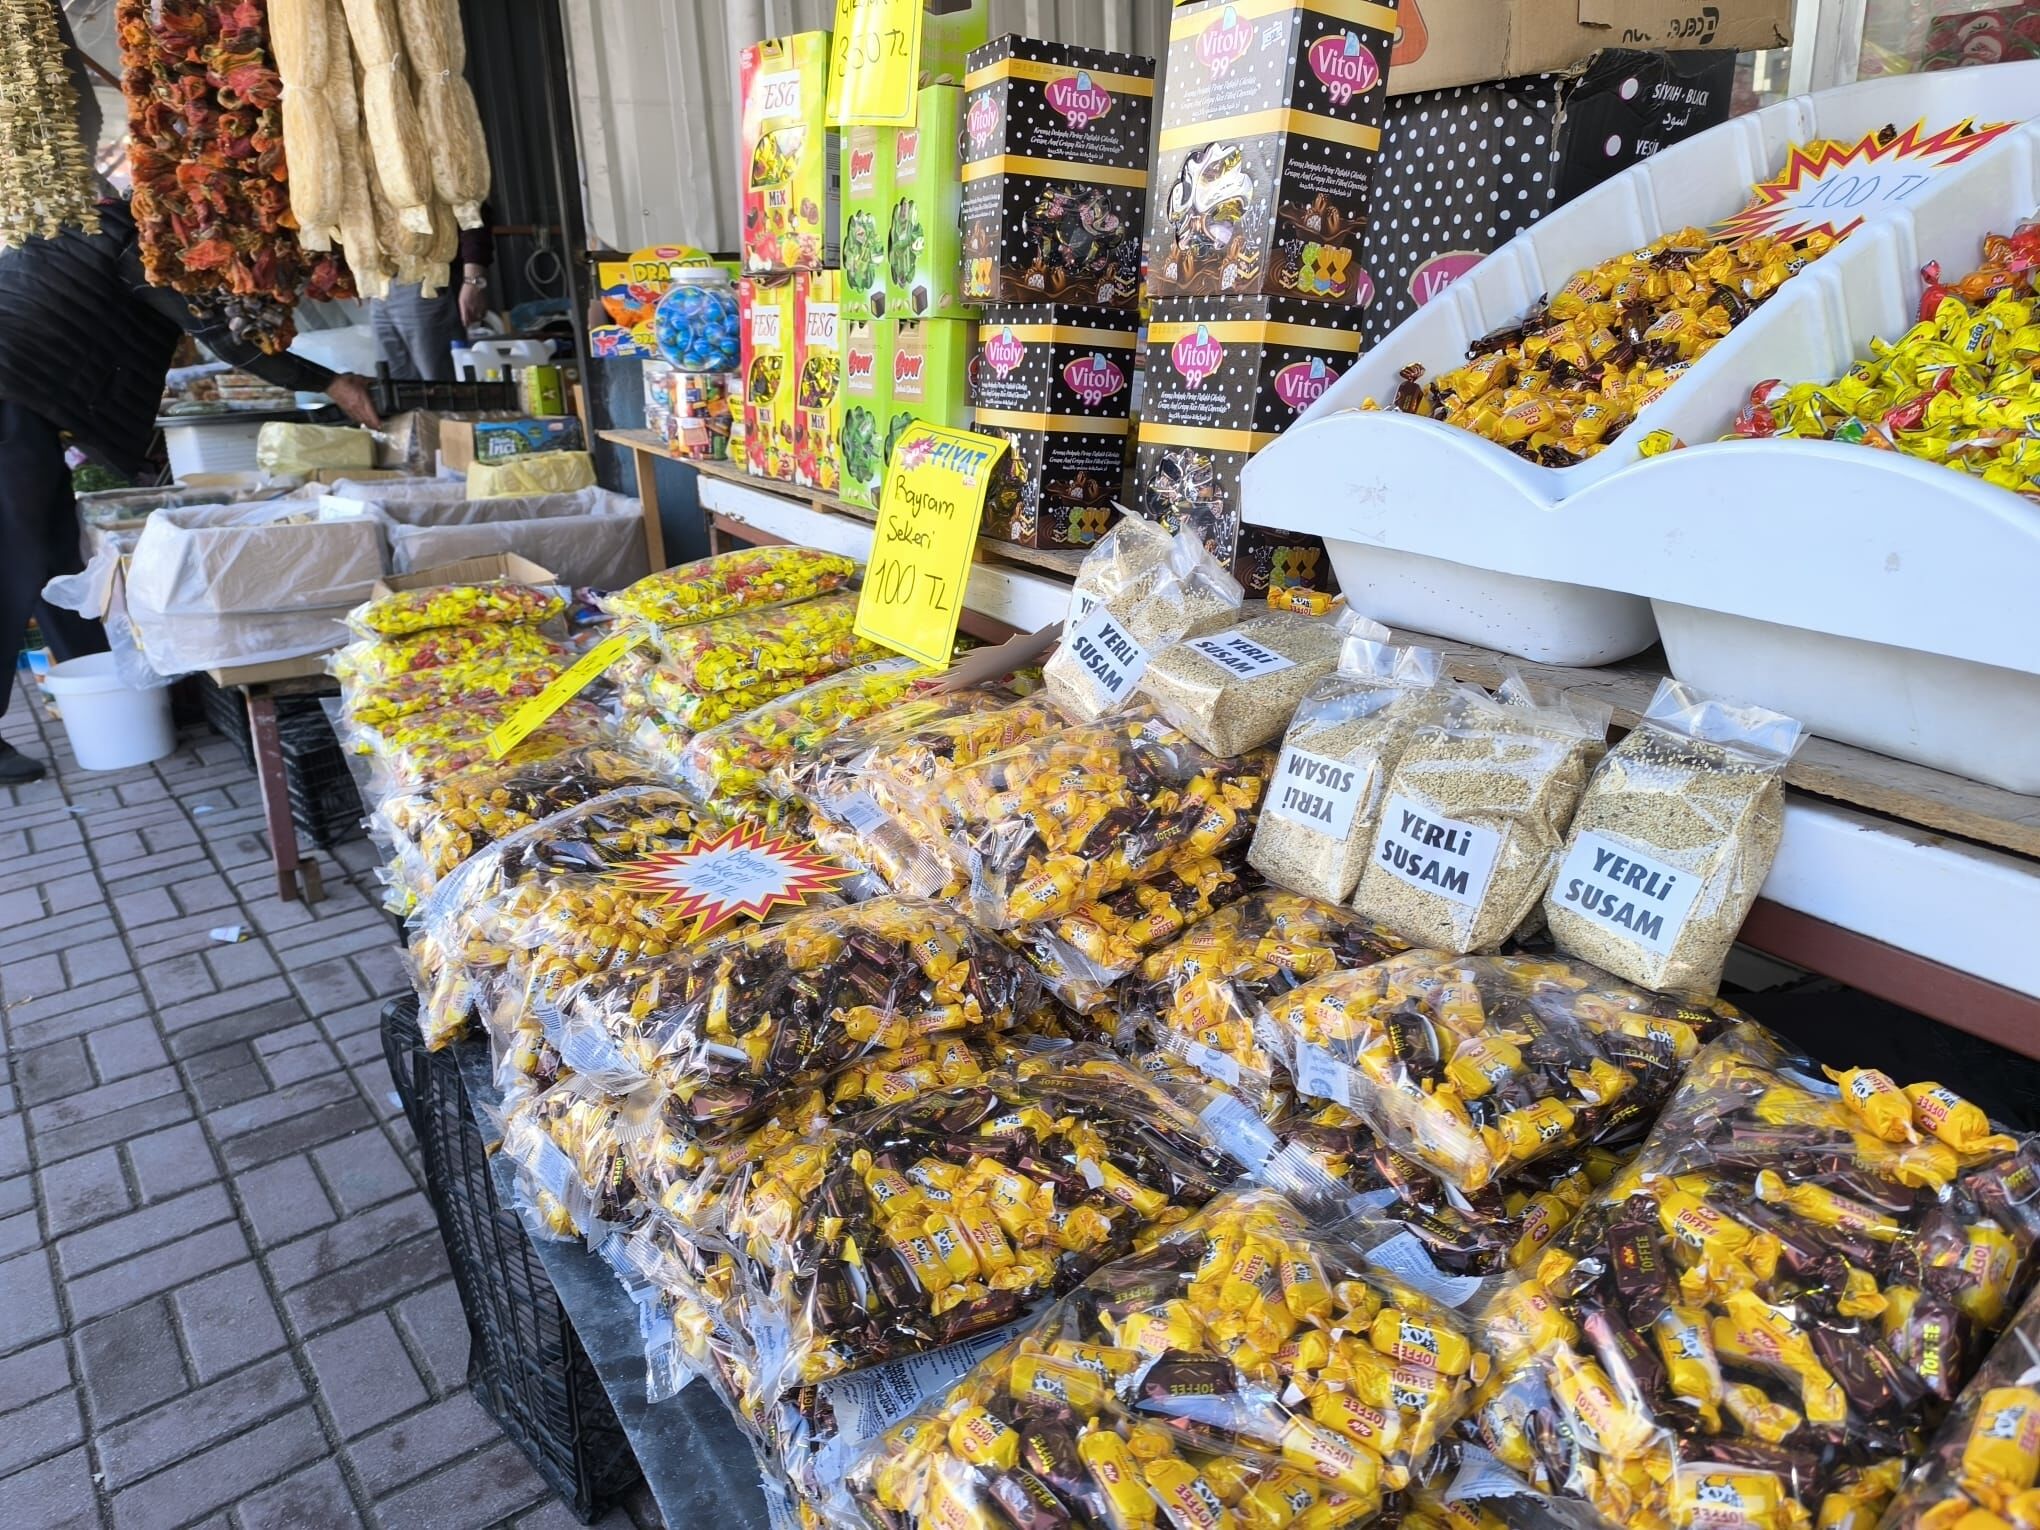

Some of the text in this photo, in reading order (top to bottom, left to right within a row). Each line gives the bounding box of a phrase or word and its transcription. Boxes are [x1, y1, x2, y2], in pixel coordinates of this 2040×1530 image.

[1203, 27, 1248, 55] Vitoly
[1210, 59, 1229, 78] 99
[1318, 46, 1375, 88] Vitoly
[1054, 84, 1108, 117] Vitoly
[1329, 81, 1351, 103] 99
[1686, 89, 1709, 107] BLACK
[971, 107, 999, 134] Vitoly
[1067, 111, 1087, 129] 99
[976, 133, 989, 149] 99
[1798, 174, 1881, 208] 100
[989, 340, 1024, 366] Vitoly
[1178, 340, 1222, 370] Vitoly
[996, 363, 1009, 379] 99
[1072, 366, 1120, 395] Vitoly
[1186, 370, 1202, 389] 99
[1083, 389, 1101, 405] 99
[1284, 373, 1333, 399] Vitol
[932, 440, 989, 477] FİYAT
[895, 474, 955, 519] Bayram
[874, 560, 948, 611] 100 TL
[1097, 622, 1140, 667] YERLi
[1195, 640, 1255, 674] SUSAM
[1226, 637, 1280, 665] YERLi
[1072, 636, 1124, 694] SUSAM
[1287, 753, 1355, 792] SUSAM
[1283, 787, 1335, 823] YERLi
[1154, 827, 1181, 841] TOFFEE
[1398, 809, 1472, 857] YERLi
[1380, 839, 1470, 895] SUSAM
[1594, 846, 1677, 901] YERLi
[1026, 874, 1053, 893] TOFFEE
[1565, 878, 1664, 941] SUSAM
[1149, 920, 1176, 938] TOFFEE
[1265, 952, 1297, 969] TOFFEE
[1916, 1095, 1949, 1122] TOFFEE
[1677, 1207, 1720, 1237] TOFFEE
[1240, 1254, 1265, 1284] TOFFEE
[1391, 1342, 1437, 1369] TOFFEE
[1344, 1396, 1388, 1430] TOFFEE
[967, 1417, 996, 1446] TOFFEE
